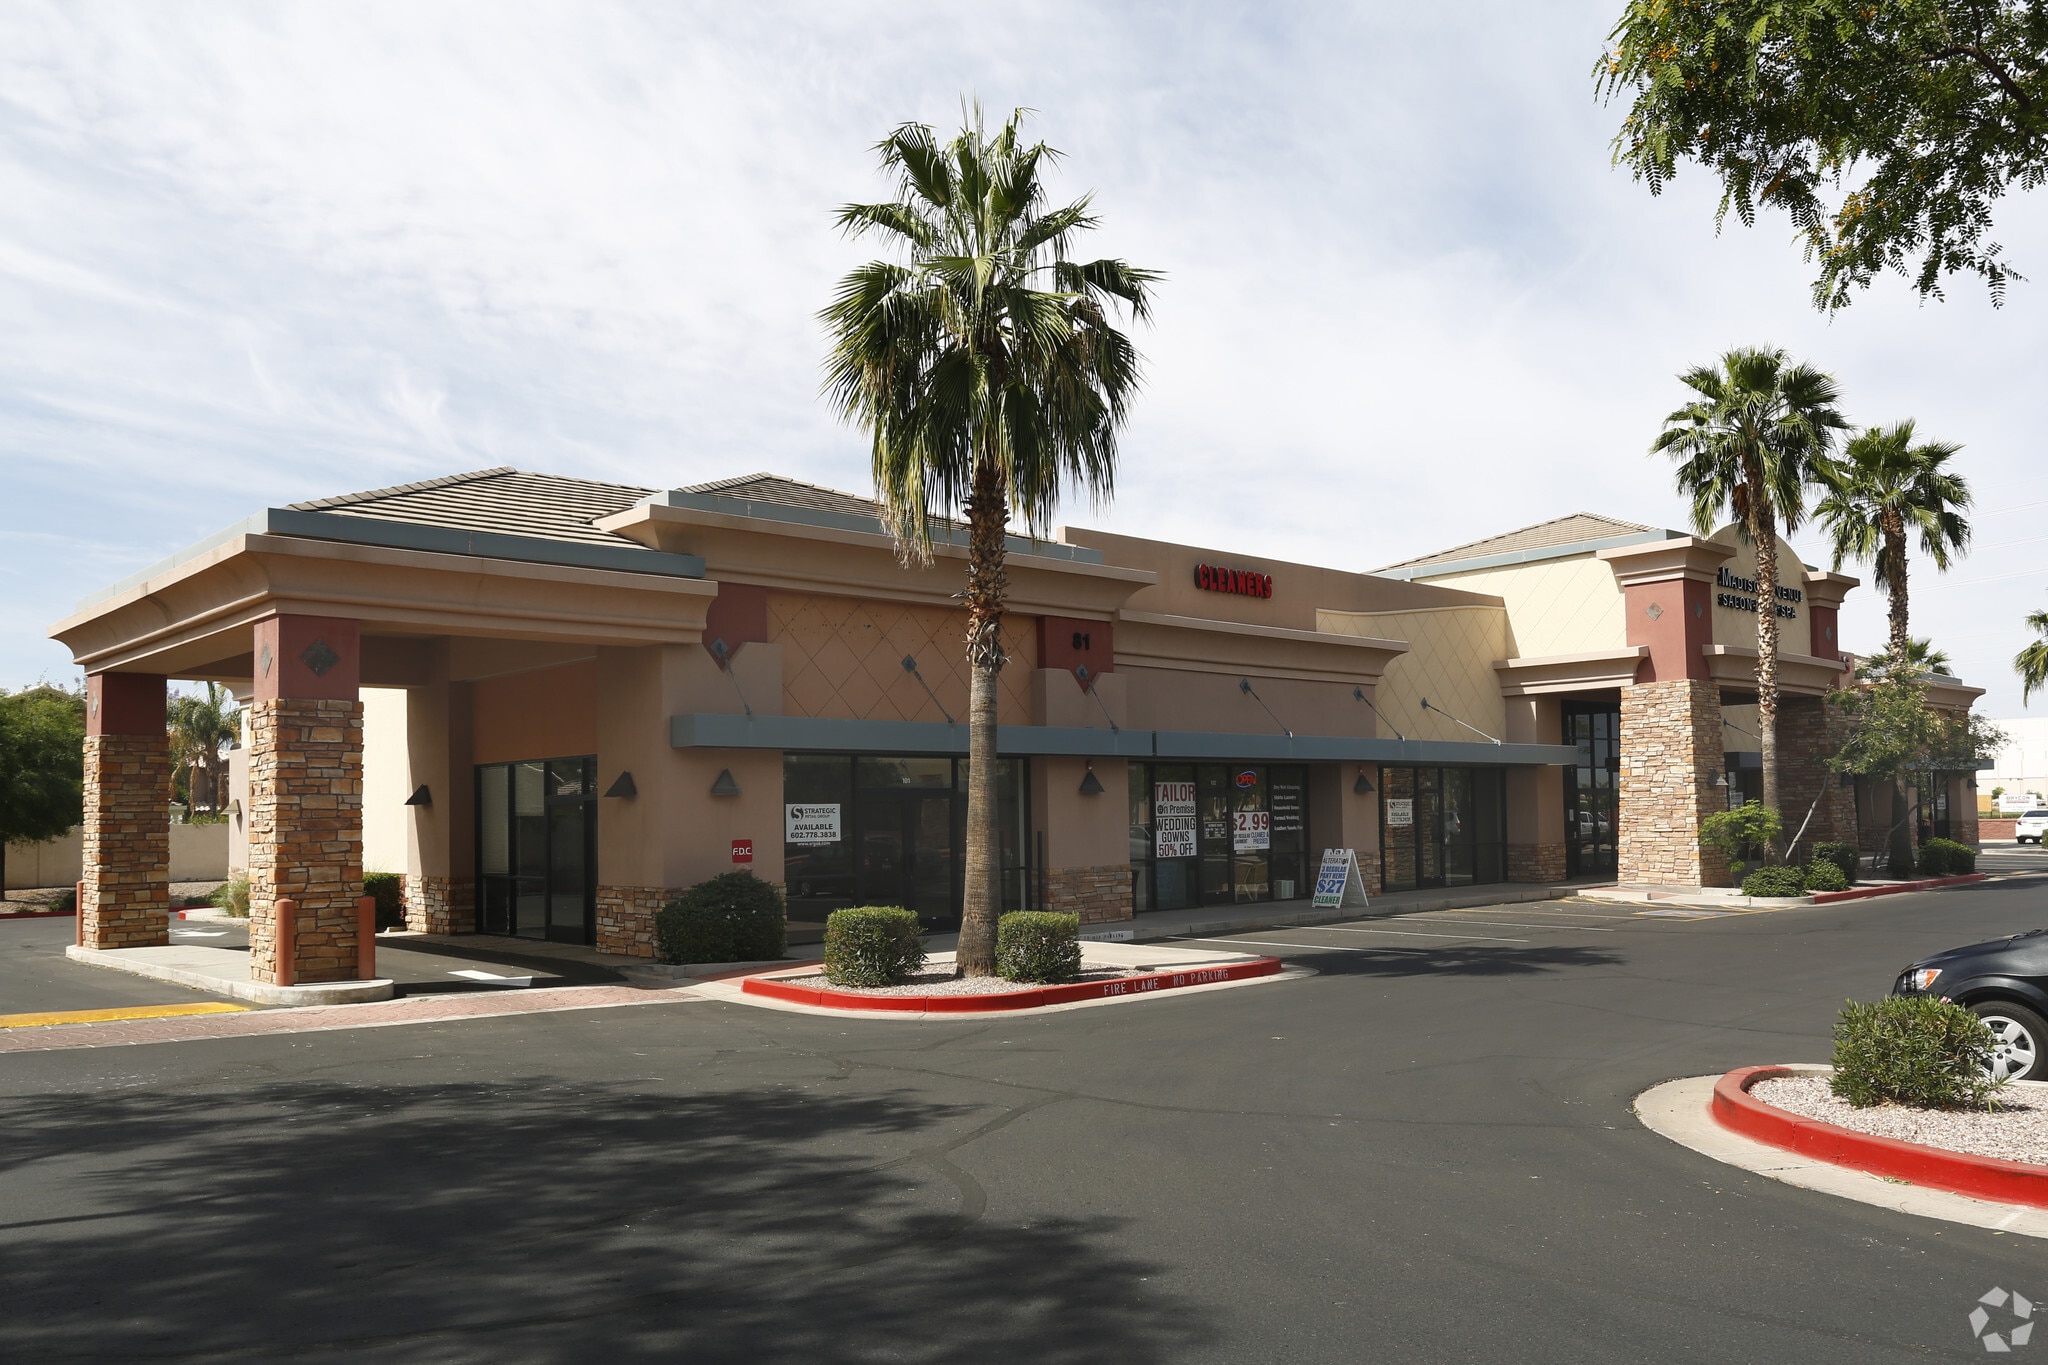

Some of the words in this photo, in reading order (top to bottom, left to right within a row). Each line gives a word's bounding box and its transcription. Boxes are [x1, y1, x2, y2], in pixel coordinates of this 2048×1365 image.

[1195, 564, 1272, 599] CLEANERS
[1718, 566, 1759, 593] MADISO
[1719, 594, 1752, 612] SALON
[1781, 604, 1796, 619] SPA
[1073, 632, 1090, 650] 81
[1236, 774, 1257, 785] OPEN
[1155, 784, 1196, 801] TAILOR
[804, 807, 836, 815] STRATEGIC
[1169, 804, 1195, 814] Premise
[794, 823, 833, 831] AVAILABLE
[1156, 818, 1196, 831] WEDDING
[790, 831, 837, 839] 602.778.3838
[1161, 831, 1190, 842] GOWNS
[1159, 844, 1177, 857] 50%
[1180, 842, 1193, 855] OFF
[1317, 879, 1345, 894] $27
[1313, 896, 1340, 904] CLEANER
[1103, 982, 1127, 996] FIRE
[1133, 978, 1160, 992] LANE
[1173, 974, 1185, 987] NO
[1190, 969, 1229, 984] PARKING
